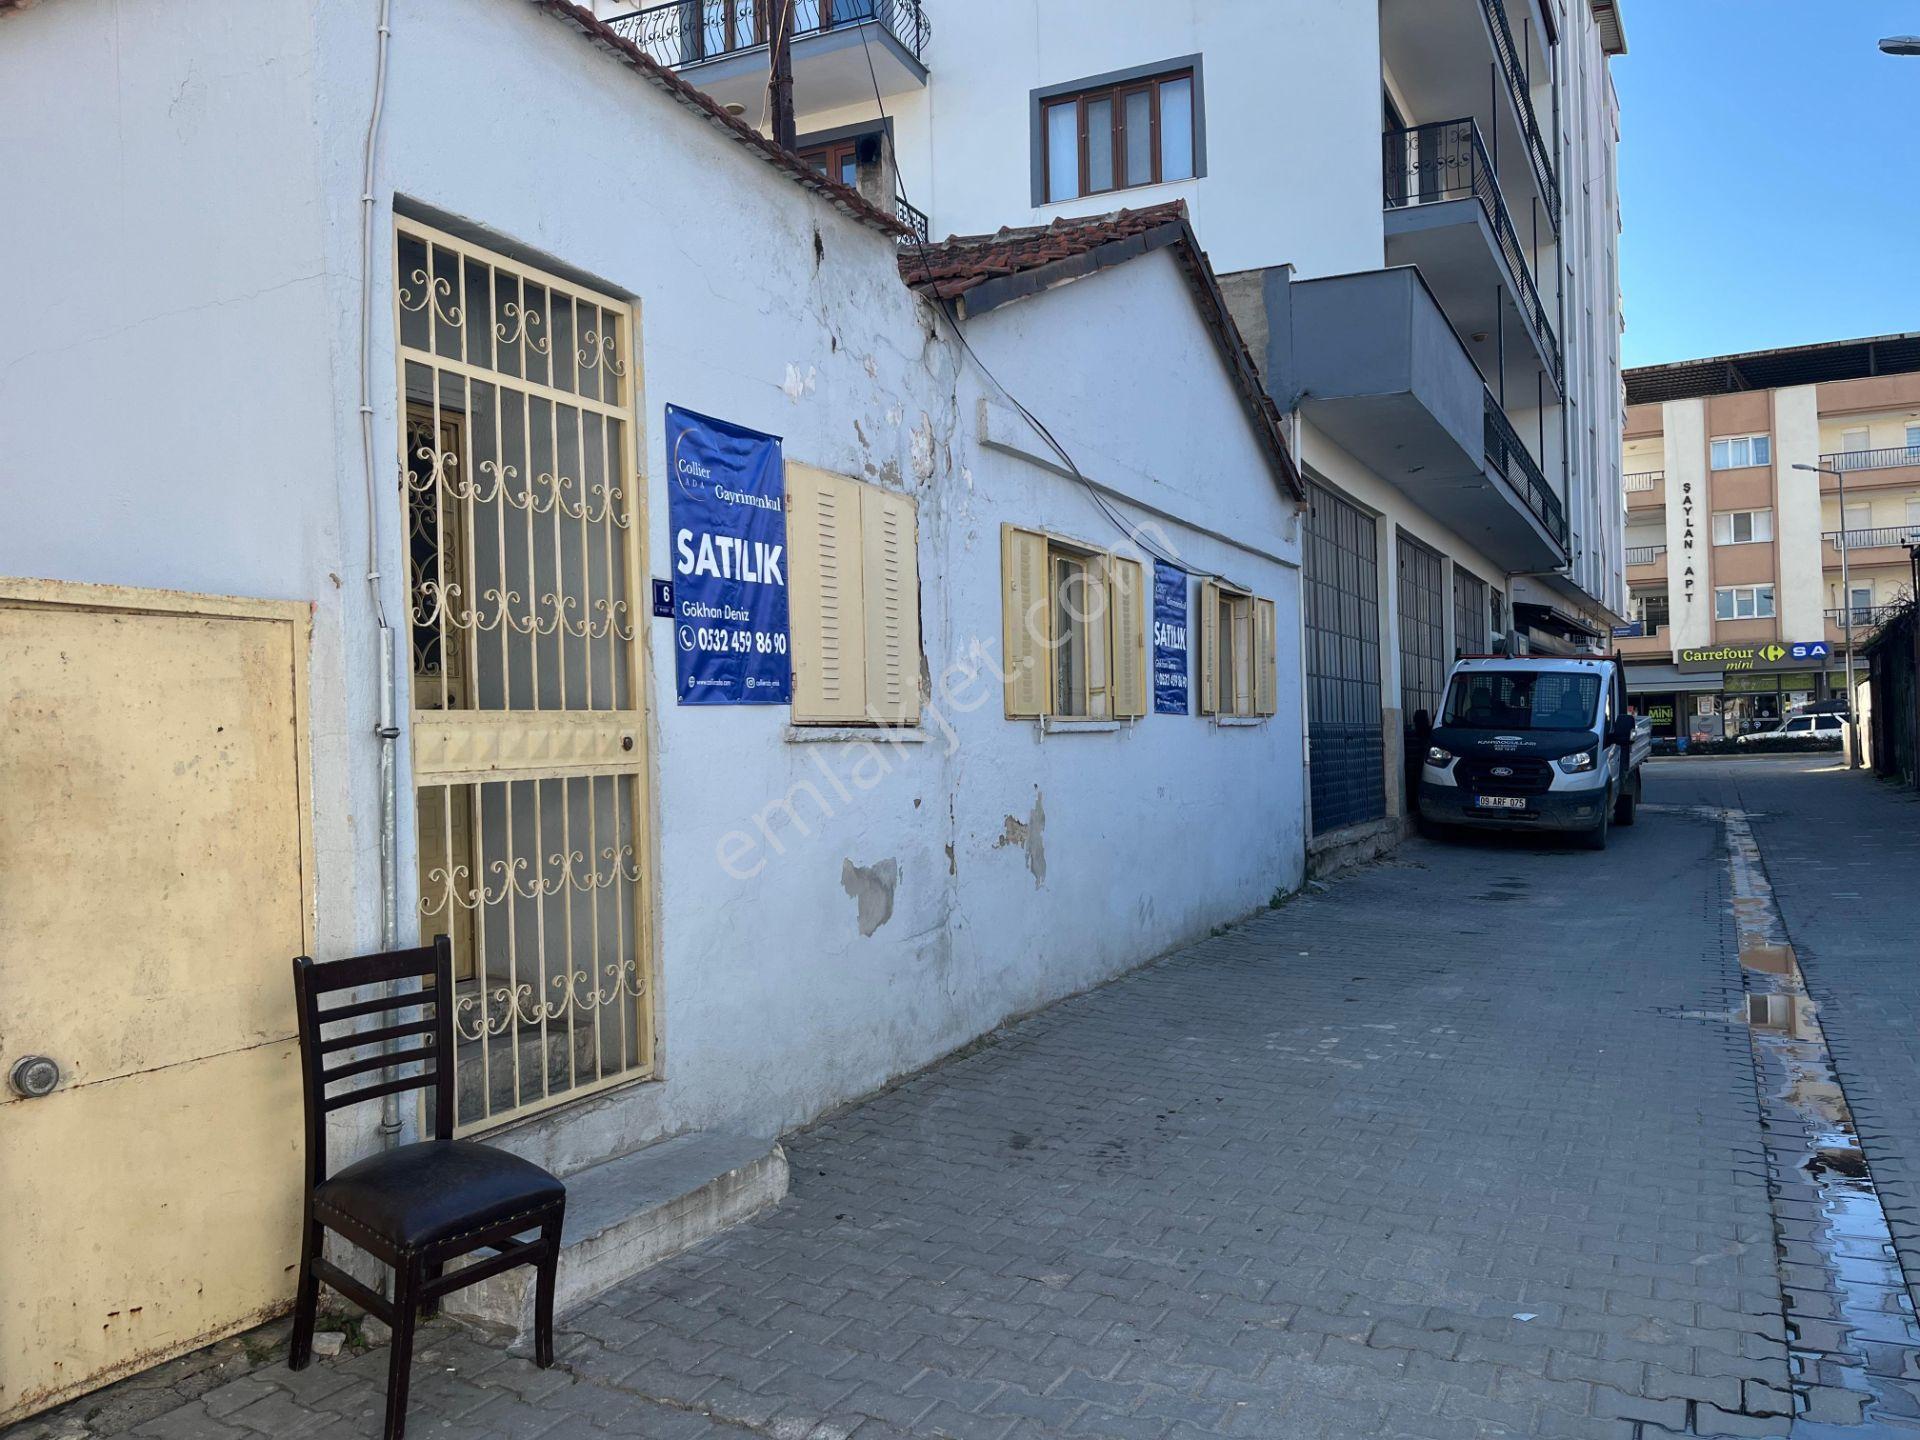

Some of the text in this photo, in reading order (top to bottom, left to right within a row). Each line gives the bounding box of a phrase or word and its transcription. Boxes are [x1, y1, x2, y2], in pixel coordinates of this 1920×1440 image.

[678, 458, 711, 479] Collier
[715, 484, 781, 512] Gayrimenkul
[677, 528, 784, 586] SATILIK
[663, 586, 670, 602] 6
[1684, 566, 1694, 602] APT
[682, 601, 750, 622] Gökhan Deniz
[698, 627, 787, 655] 0532 459 86 90
[1154, 621, 1186, 651] SATILIK
[1683, 647, 1754, 662] Carrefour
[1726, 660, 1754, 670] mini
